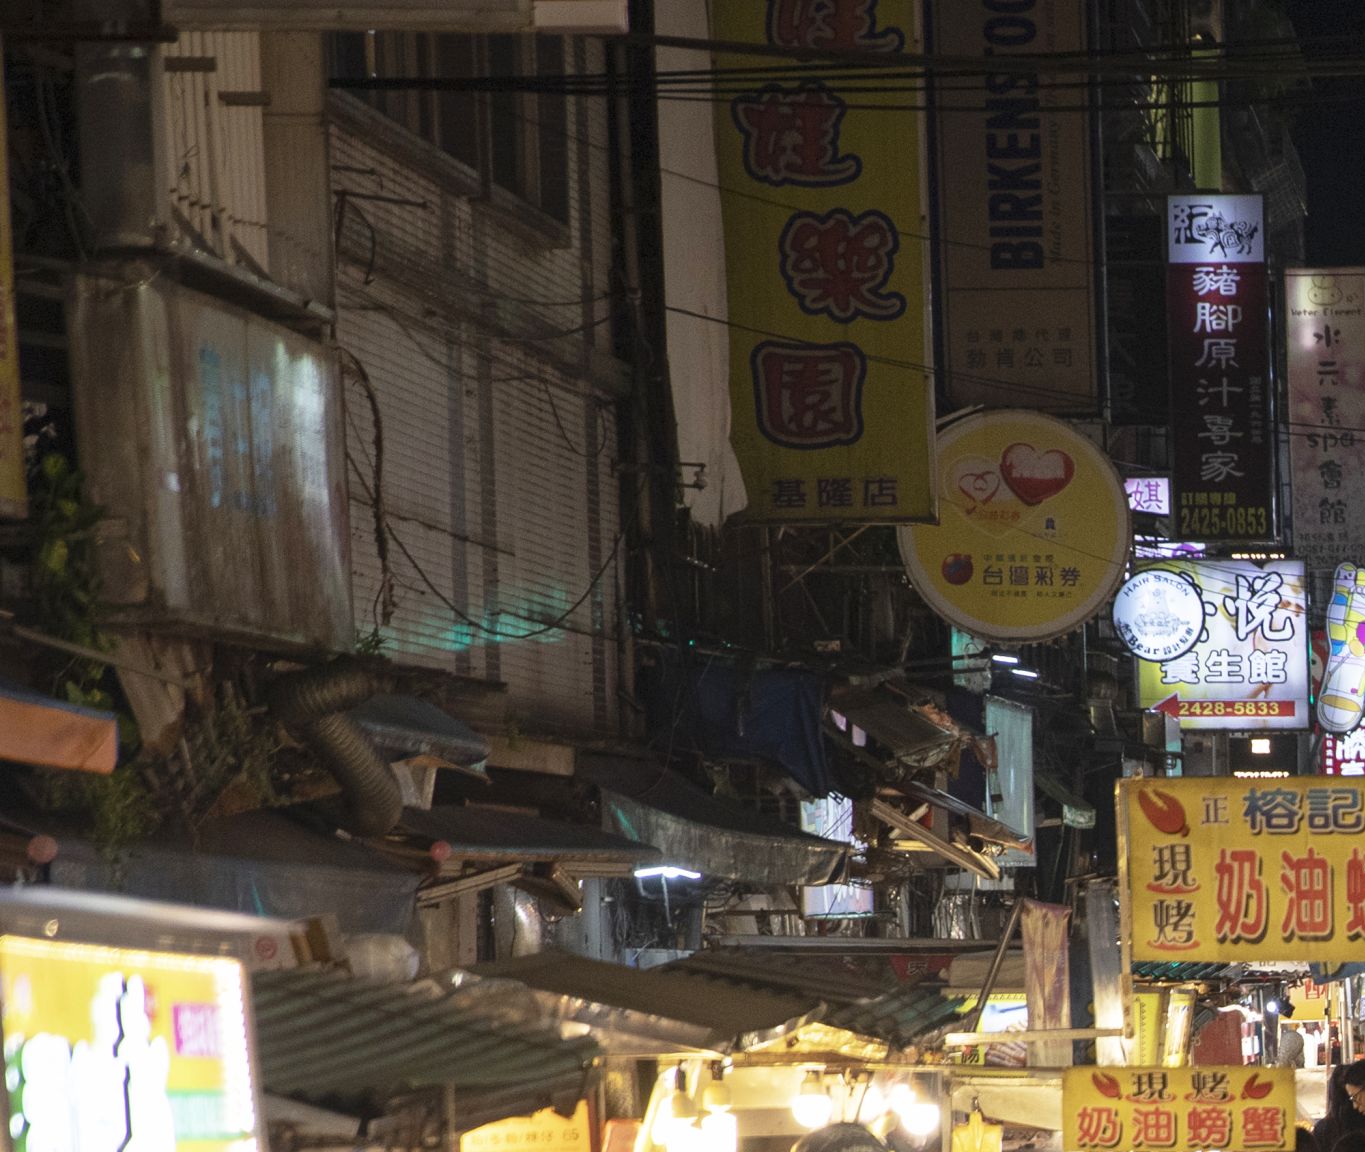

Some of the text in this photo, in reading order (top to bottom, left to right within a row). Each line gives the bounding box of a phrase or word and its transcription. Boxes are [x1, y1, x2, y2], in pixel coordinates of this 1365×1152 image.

[1181, 505, 1268, 536] 2425-0853
[983, 565, 1082, 588] 台灣彩券
[1178, 702, 1281, 717] 2428-5833
[1200, 797, 1230, 826] 正
[1151, 843, 1197, 945] 現烤
[1131, 1071, 1231, 1101] 現烤
[1076, 1106, 1285, 1149] 奶油螃蟹
